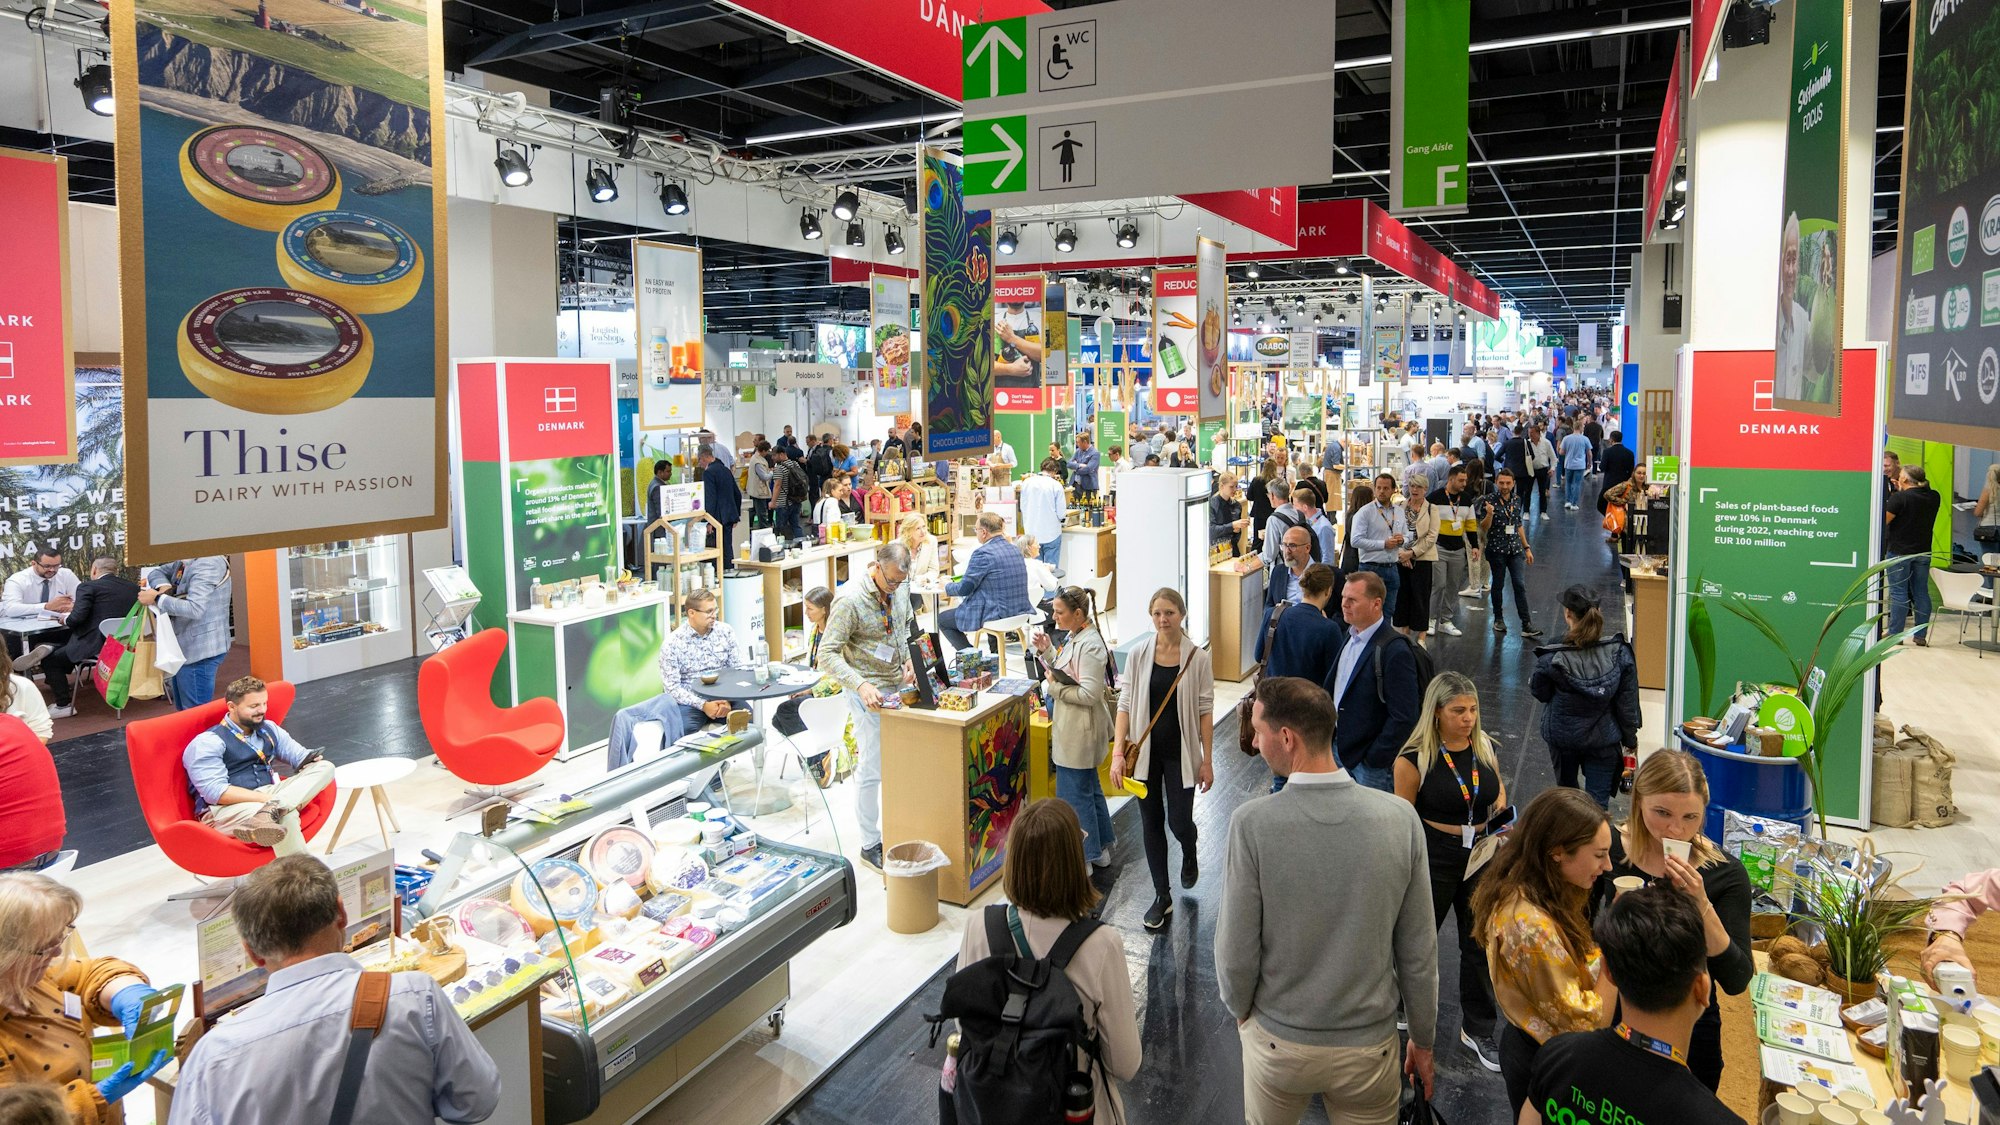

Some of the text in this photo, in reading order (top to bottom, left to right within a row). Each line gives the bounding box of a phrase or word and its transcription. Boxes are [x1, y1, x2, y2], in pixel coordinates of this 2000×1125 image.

[1067, 30, 1090, 45] WC
[1798, 65, 1832, 113] Sustainable
[1802, 102, 1823, 133] FOCUS
[1406, 142, 1453, 154] Gang Aisle
[1437, 165, 1460, 205] F
[1952, 223, 1965, 236] USDA
[994, 287, 1035, 297] REDUCED
[1257, 342, 1290, 350] DAABON
[538, 421, 585, 432] DENMARK
[1740, 423, 1820, 435] DENMARK
[933, 434, 988, 448] CHOCOLATE AND LOVE
[184, 428, 347, 478] Thise
[1656, 472, 1678, 481] F79
[195, 475, 413, 503] DAIRY WITH PASSION
[525, 487, 549, 497] Organic
[86, 488, 124, 504] WE
[525, 497, 547, 505] around
[525, 508, 541, 516] retail
[1715, 501, 1839, 514] Sales of plant-based foods
[0, 509, 125, 536] RESPECT
[526, 516, 546, 526] market
[546, 514, 564, 523] share
[582, 509, 598, 517] world
[1715, 514, 1818, 525] grew 10% in Denmark
[1715, 525, 1745, 535] during
[1746, 526, 1771, 536] 2022,
[1773, 528, 1814, 538] reaching
[0, 531, 126, 559] NATURE
[1715, 536, 1786, 547] EUR 100 million
[343, 863, 368, 877] OCEAN
[1571, 1085, 1596, 1114] The
